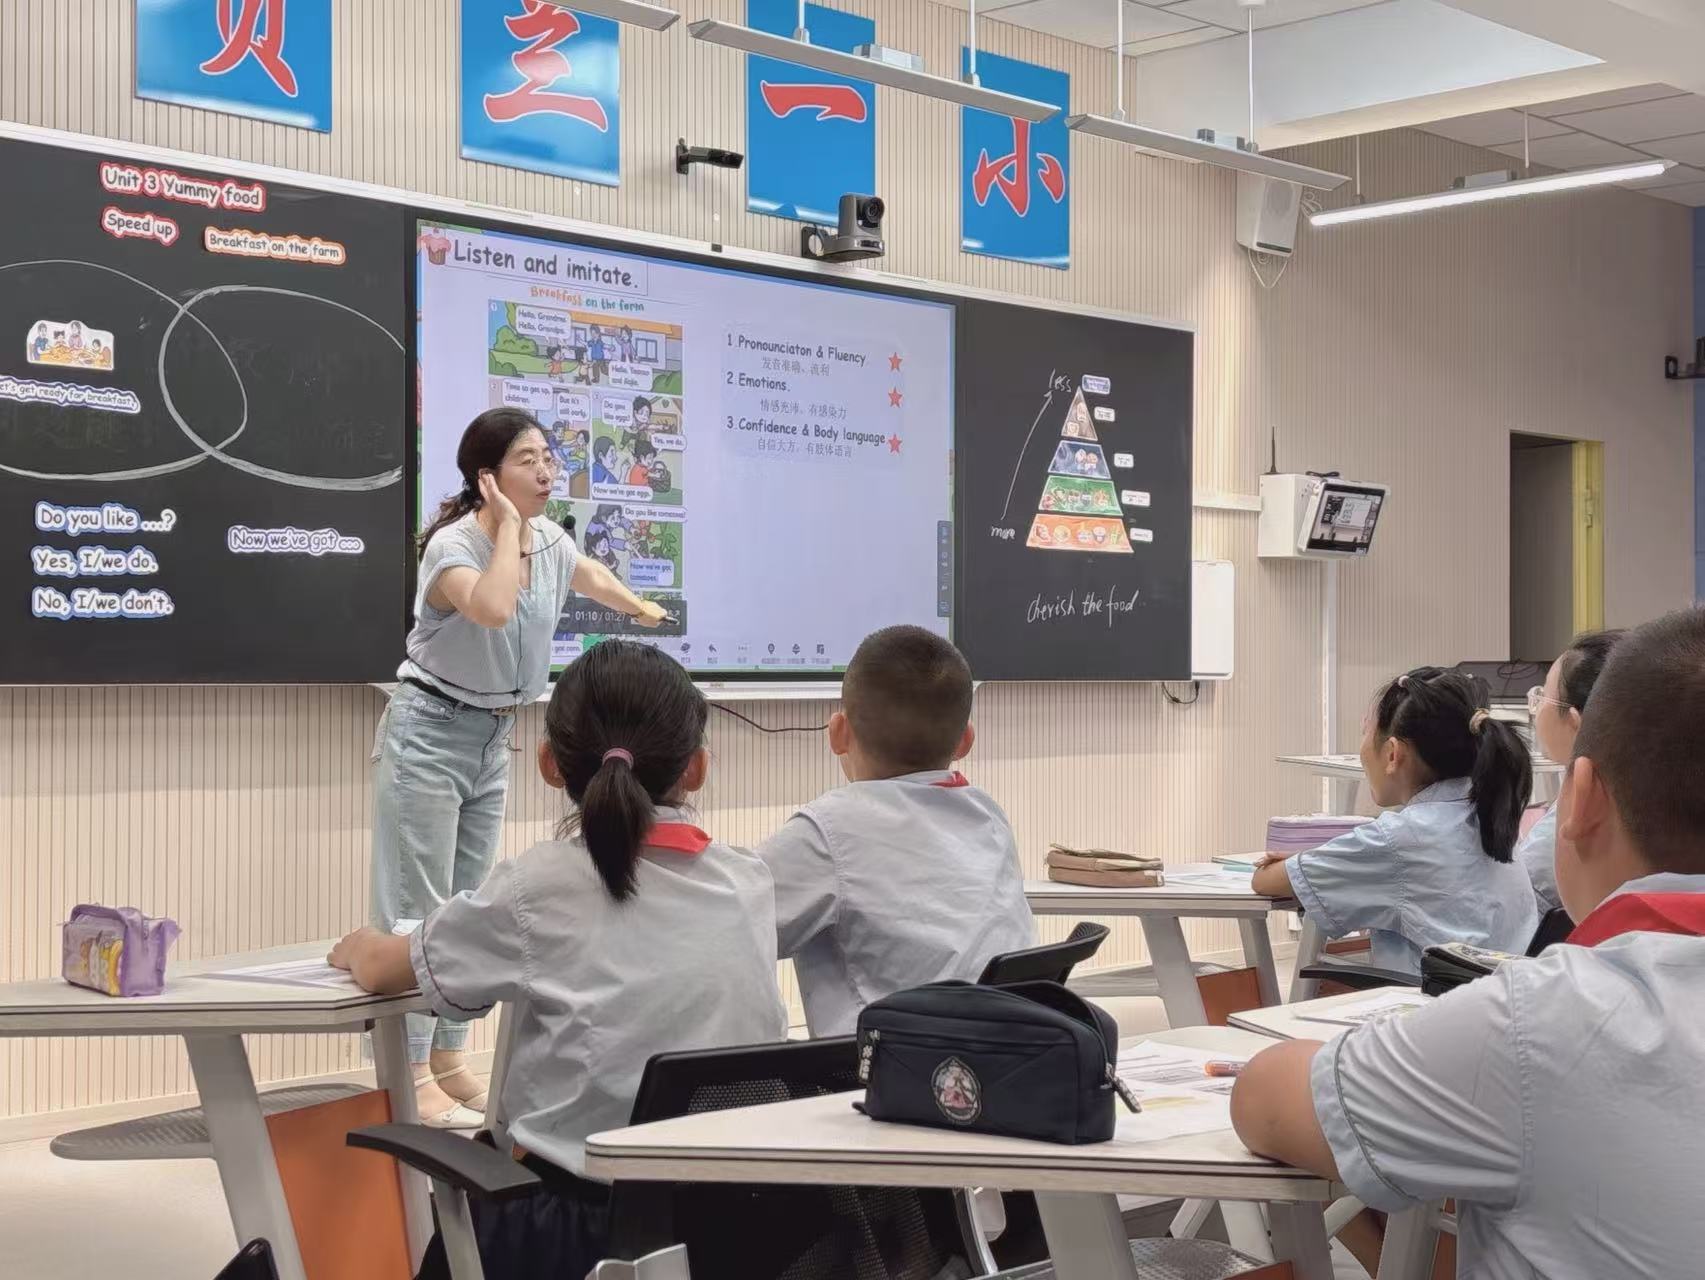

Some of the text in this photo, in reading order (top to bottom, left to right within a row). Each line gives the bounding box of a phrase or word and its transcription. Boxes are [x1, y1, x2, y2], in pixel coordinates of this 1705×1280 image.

[759, 80, 867, 123] 一
[972, 117, 1065, 218] 小
[105, 169, 260, 205] Unit 3 Yummy food
[107, 213, 173, 238] Speed up
[209, 232, 340, 259] Breakfast on the farm
[454, 239, 638, 289] Listen and imitate.
[530, 286, 583, 306] Breakfast
[585, 296, 598, 308] on
[600, 295, 617, 311] the
[738, 334, 812, 358] Pronounciaton
[816, 345, 824, 359] &
[828, 346, 867, 368] Fluency
[19, 385, 35, 395] get
[39, 386, 66, 398] ready
[69, 388, 84, 399] for
[738, 373, 792, 393] Emotions.
[738, 417, 797, 436] Confidence
[802, 423, 810, 437] &
[814, 425, 839, 443] Body
[843, 428, 886, 447] language
[41, 509, 63, 526] Do
[70, 512, 99, 529] you
[106, 509, 134, 526] like
[234, 530, 265, 546] Now
[269, 530, 306, 546] we've
[313, 532, 336, 549] got
[37, 552, 156, 572] Yes, I/we do.
[38, 593, 172, 612] No, I/we don't.
[1082, 591, 1102, 616] the
[1105, 584, 1140, 628] food
[575, 611, 597, 621] 01:10
